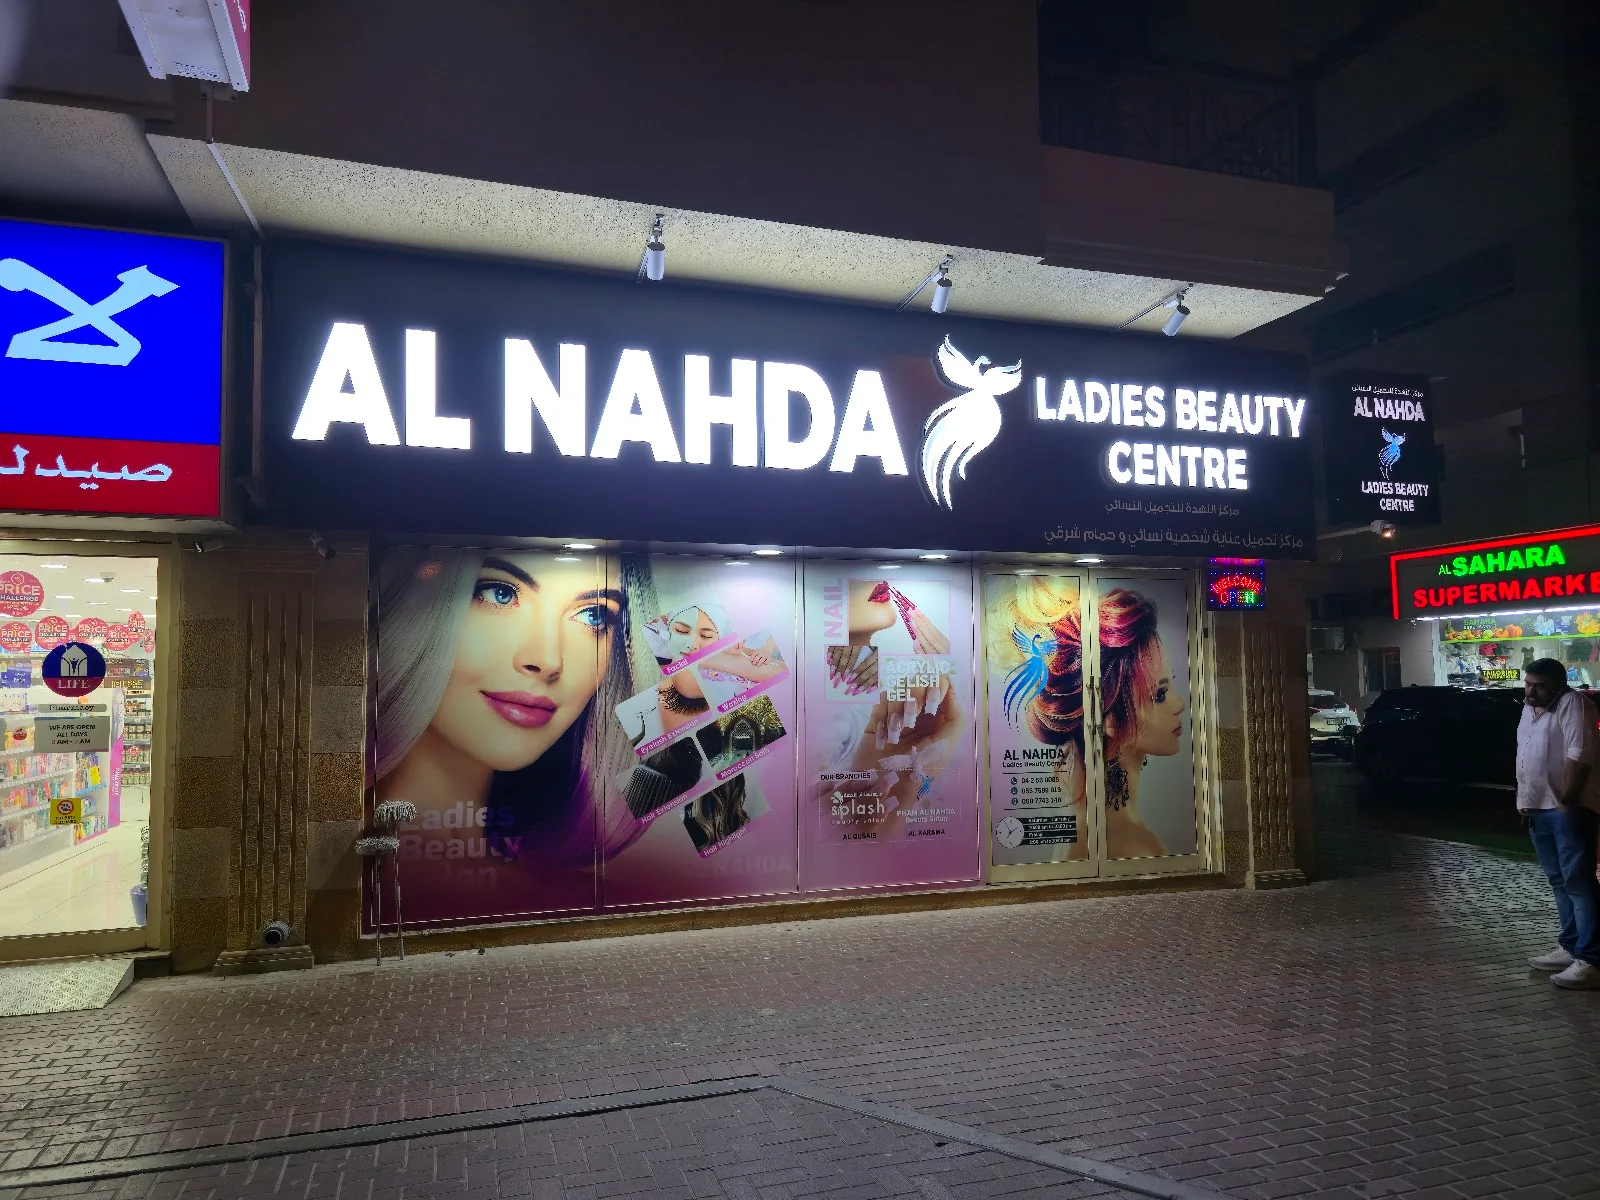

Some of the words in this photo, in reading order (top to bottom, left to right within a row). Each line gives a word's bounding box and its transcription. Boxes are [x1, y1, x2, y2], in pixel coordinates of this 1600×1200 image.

[291, 322, 471, 450] AL
[504, 338, 909, 476] NAHDA
[1036, 376, 1166, 428] LADIES
[1174, 388, 1306, 437] BEAUTY
[1353, 396, 1373, 417] AL
[1373, 397, 1426, 422] NAHDA
[1108, 441, 1248, 490] CENTRE
[1361, 480, 1393, 495] LADIES
[1394, 482, 1429, 497] BEAUTY
[1104, 499, 1143, 515] النسائي
[1144, 501, 1184, 515] للتجميل
[1185, 502, 1217, 514] النهدة
[1219, 503, 1240, 517] مركز
[1379, 497, 1415, 512] CENTRE
[1044, 523, 1081, 546] شرقي
[1083, 527, 1116, 542] حمام
[1118, 532, 1126, 544] و
[1166, 527, 1211, 546] شخصية
[1212, 529, 1241, 548] عناية
[1242, 532, 1277, 549] تجميل
[1279, 532, 1304, 549] مركز
[1438, 564, 1451, 576] AL
[1452, 544, 1566, 577] SAHARA
[823, 578, 843, 639] NAIL
[38, 624, 68, 633] PRICE
[78, 624, 108, 633] PRICE
[1463, 617, 1497, 626] SAHARA
[1, 630, 31, 638] PRICE
[666, 658, 689, 675] Facial
[886, 660, 950, 675] ACRYLIC
[58, 679, 90, 689] LIFE
[886, 674, 940, 688] GELISH
[886, 688, 917, 702] GEL
[720, 695, 747, 712] Waxing
[640, 736, 668, 755] Eyelash
[1003, 749, 1020, 761] AL
[1022, 748, 1065, 760] NAHDA
[820, 773, 835, 781] OUR
[835, 772, 871, 781] BRANCHES
[831, 798, 885, 820] splash
[905, 815, 928, 824] Beauty
[928, 815, 948, 823] Salon
[400, 832, 524, 863] Beauty
